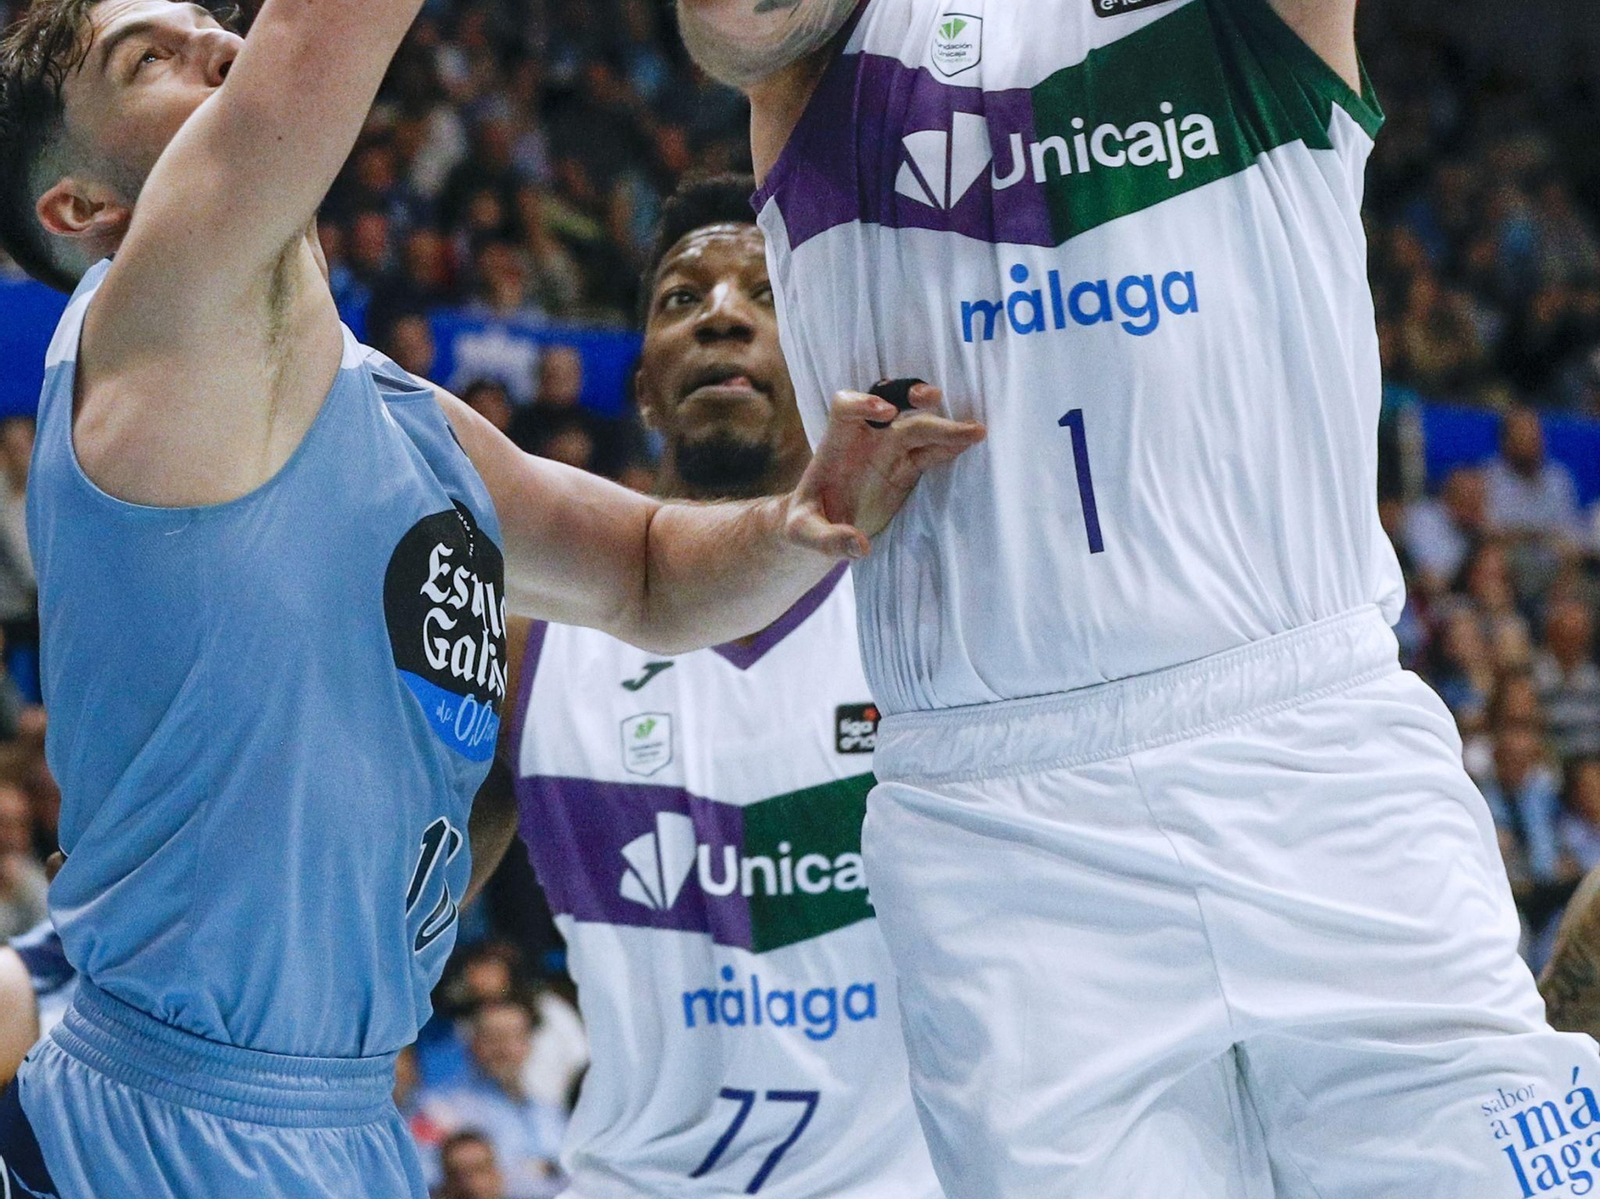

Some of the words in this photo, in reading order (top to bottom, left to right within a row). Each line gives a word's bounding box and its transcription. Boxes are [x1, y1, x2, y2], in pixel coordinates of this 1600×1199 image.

[991, 102, 1220, 191] Unicaja
[1057, 408, 1105, 554] 1
[697, 842, 872, 905] Unica
[1481, 1083, 1536, 1118] sabor
[1490, 1119, 1511, 1140] a
[690, 1087, 820, 1195] 77
